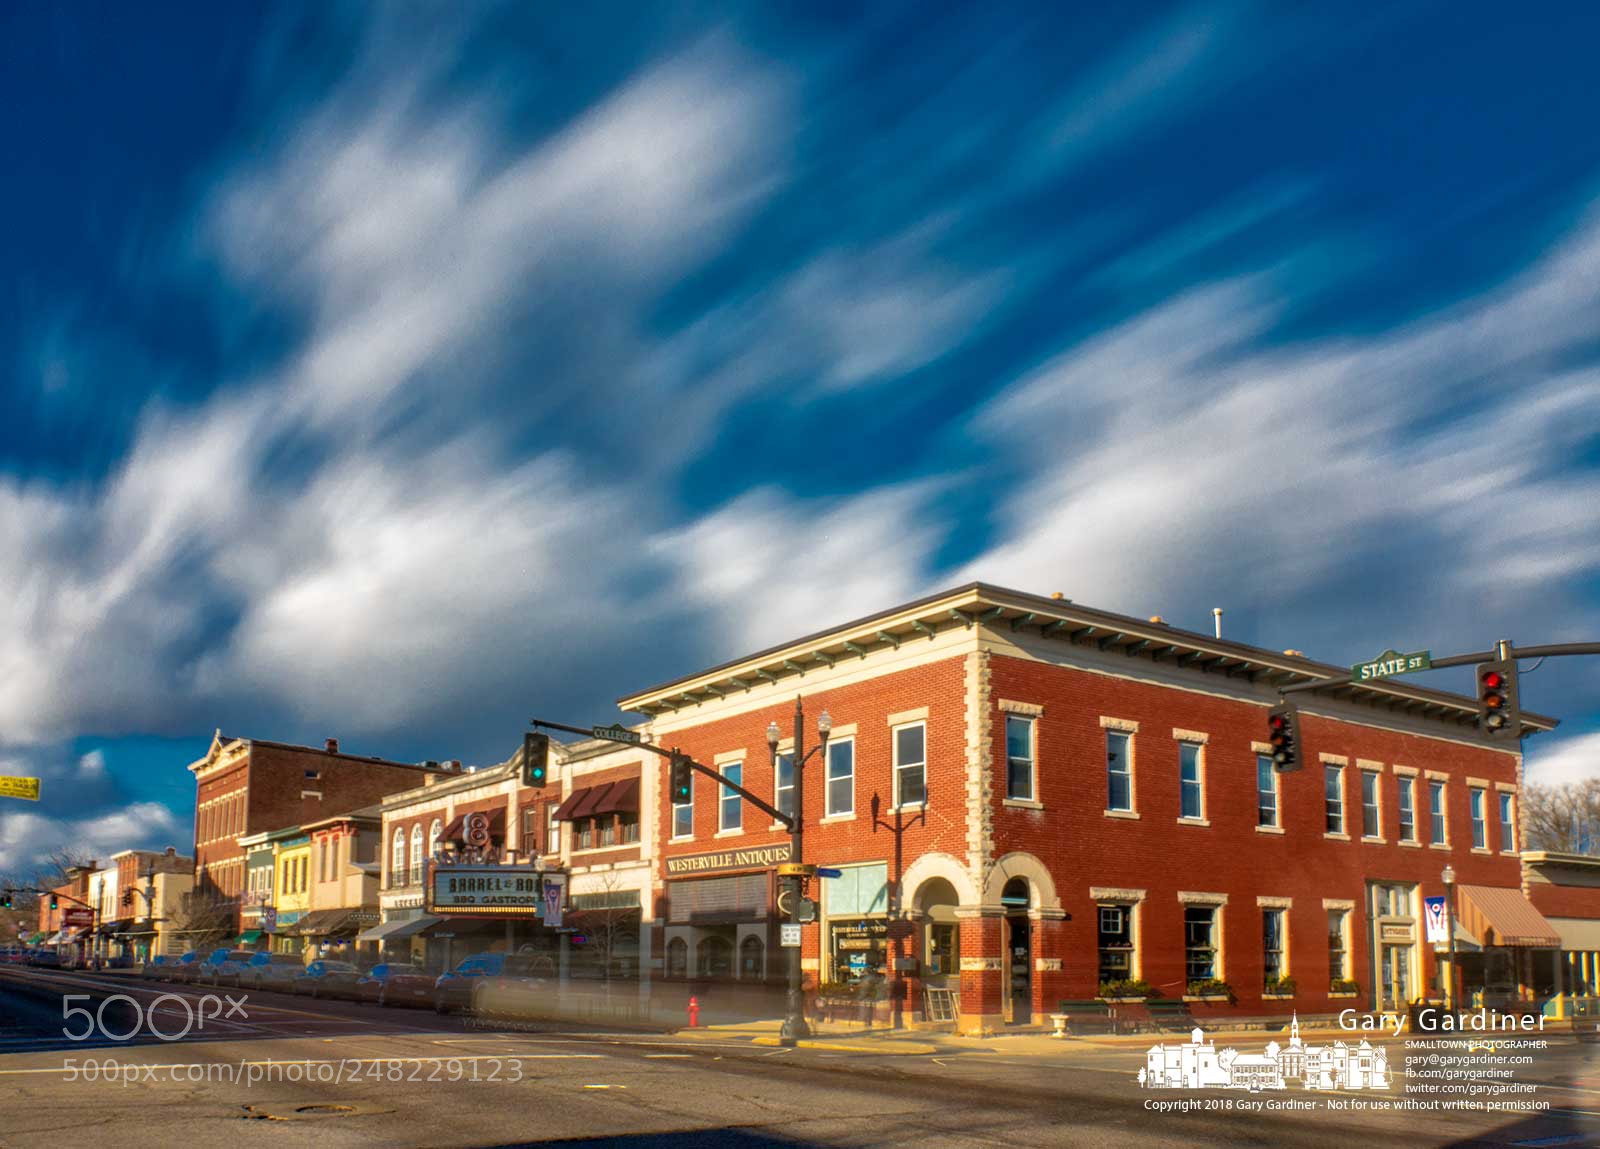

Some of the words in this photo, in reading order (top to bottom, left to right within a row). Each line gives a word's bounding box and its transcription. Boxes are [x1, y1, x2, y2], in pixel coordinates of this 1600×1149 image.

[1361, 658, 1406, 679] STATE
[1408, 656, 1423, 668] ST
[594, 728, 632, 743] COLLEGE
[667, 853, 733, 872] WESTERVILLE
[734, 847, 790, 865] ANTIQUES
[449, 878, 503, 893] BARREL
[453, 895, 476, 904] BBQ
